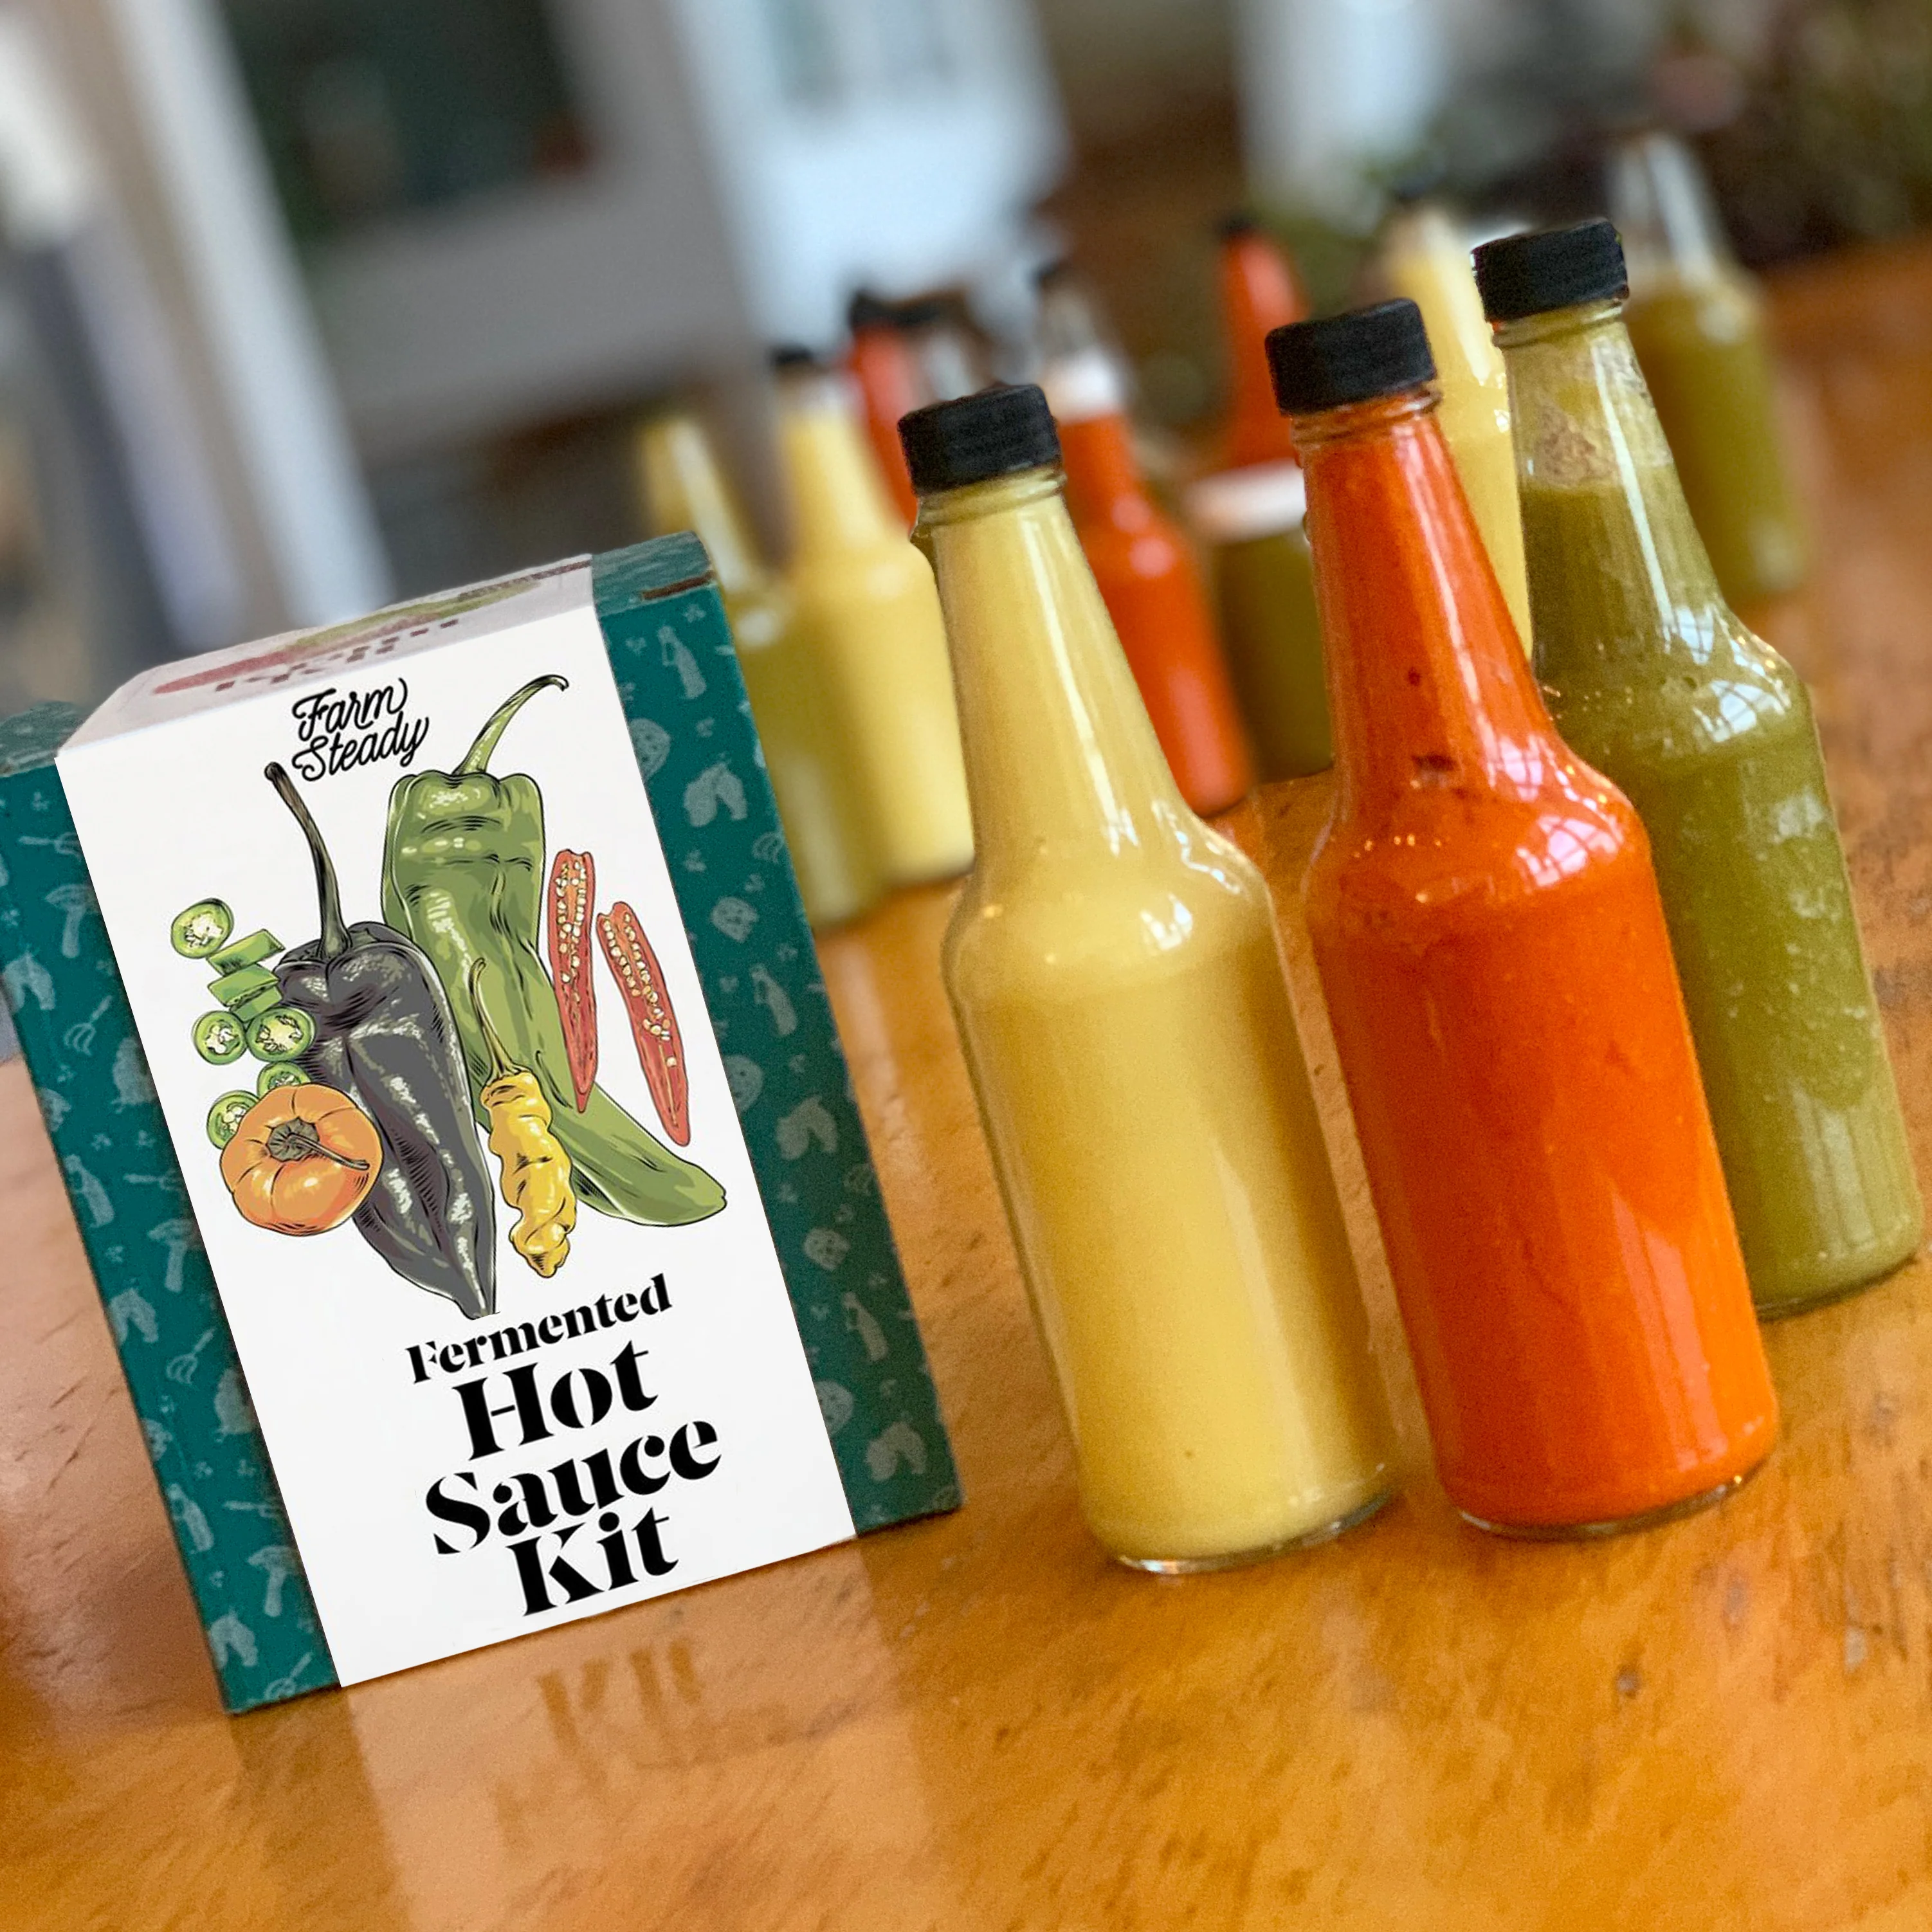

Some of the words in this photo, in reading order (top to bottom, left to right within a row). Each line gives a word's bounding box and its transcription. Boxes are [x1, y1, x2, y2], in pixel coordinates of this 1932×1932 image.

[291, 677, 408, 742] Farm
[291, 711, 430, 782] Steady
[406, 1273, 673, 1384] Fermented
[451, 1340, 659, 1461] Hot
[425, 1421, 722, 1555] Sauce
[506, 1507, 679, 1616] Kit
